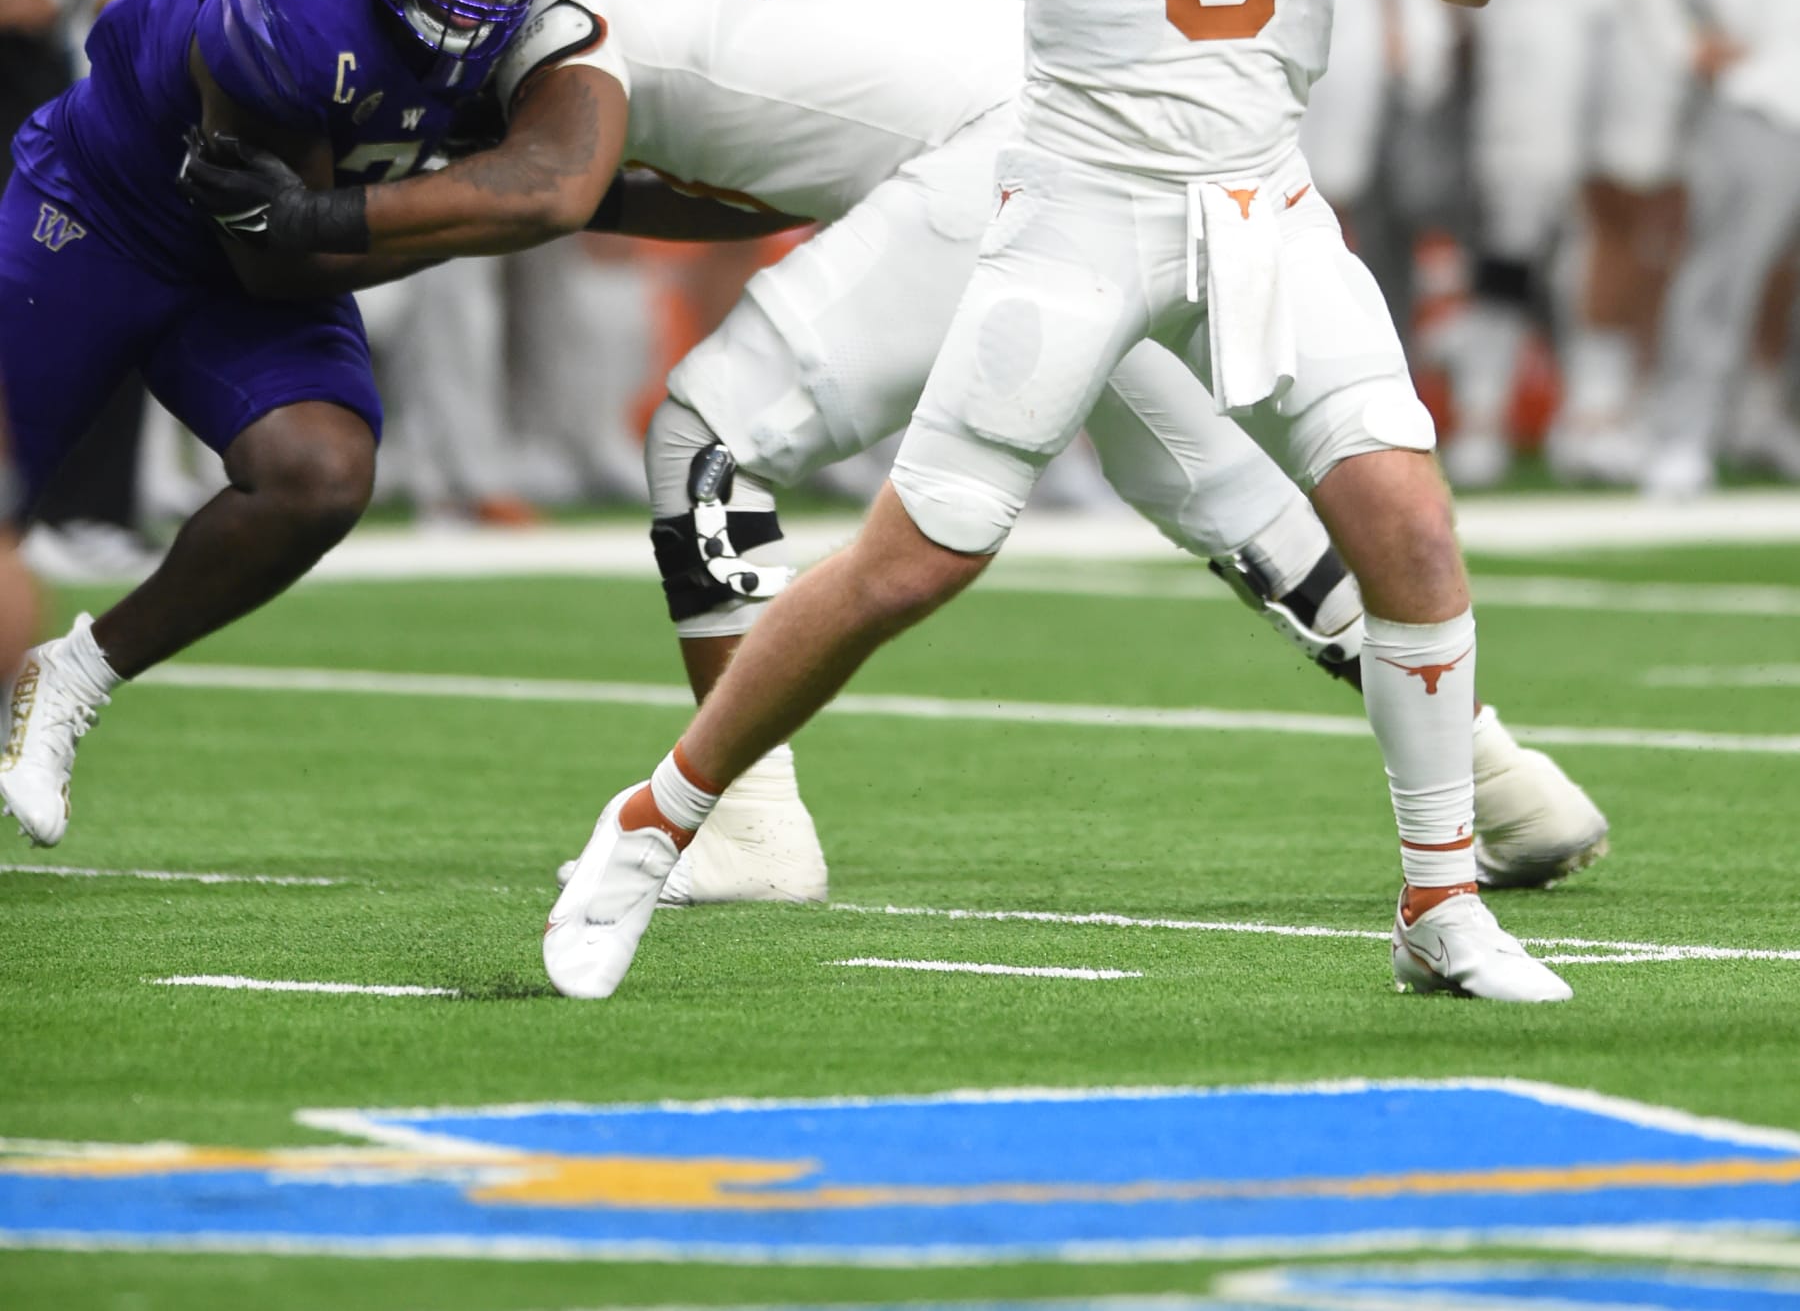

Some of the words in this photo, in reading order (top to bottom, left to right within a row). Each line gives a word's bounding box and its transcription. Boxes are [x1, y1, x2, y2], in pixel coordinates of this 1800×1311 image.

[333, 51, 357, 104] C
[401, 107, 427, 131] W
[32, 202, 88, 253] W
